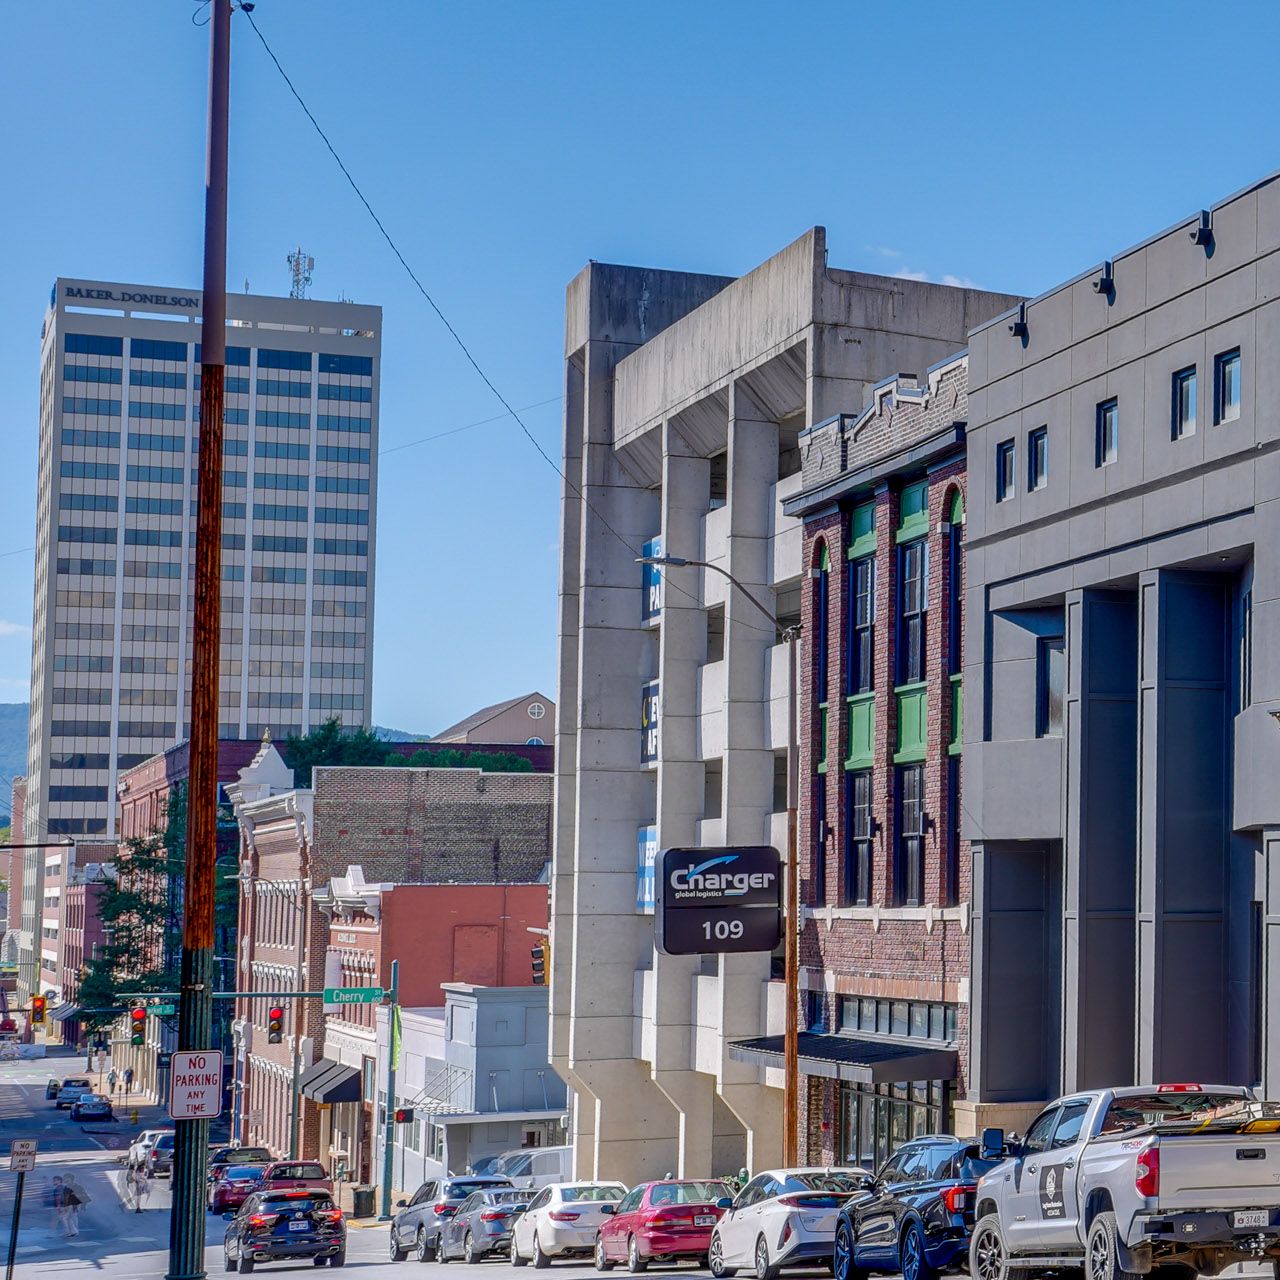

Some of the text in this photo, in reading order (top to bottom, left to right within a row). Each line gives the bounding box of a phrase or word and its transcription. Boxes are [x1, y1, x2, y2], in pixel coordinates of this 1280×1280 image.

[65, 287, 199, 308] BAKER DONELSON
[670, 864, 775, 894] Charger
[675, 890, 722, 899] global logistics
[702, 920, 744, 940] 109
[333, 990, 364, 1002] Cherry
[188, 1057, 206, 1070] NO
[175, 1073, 218, 1087] PARKING
[187, 1091, 206, 1100] ANY
[186, 1103, 206, 1113] TIME
[20, 1142, 30, 1150] NO
[1245, 1215, 1261, 1224] 3748
